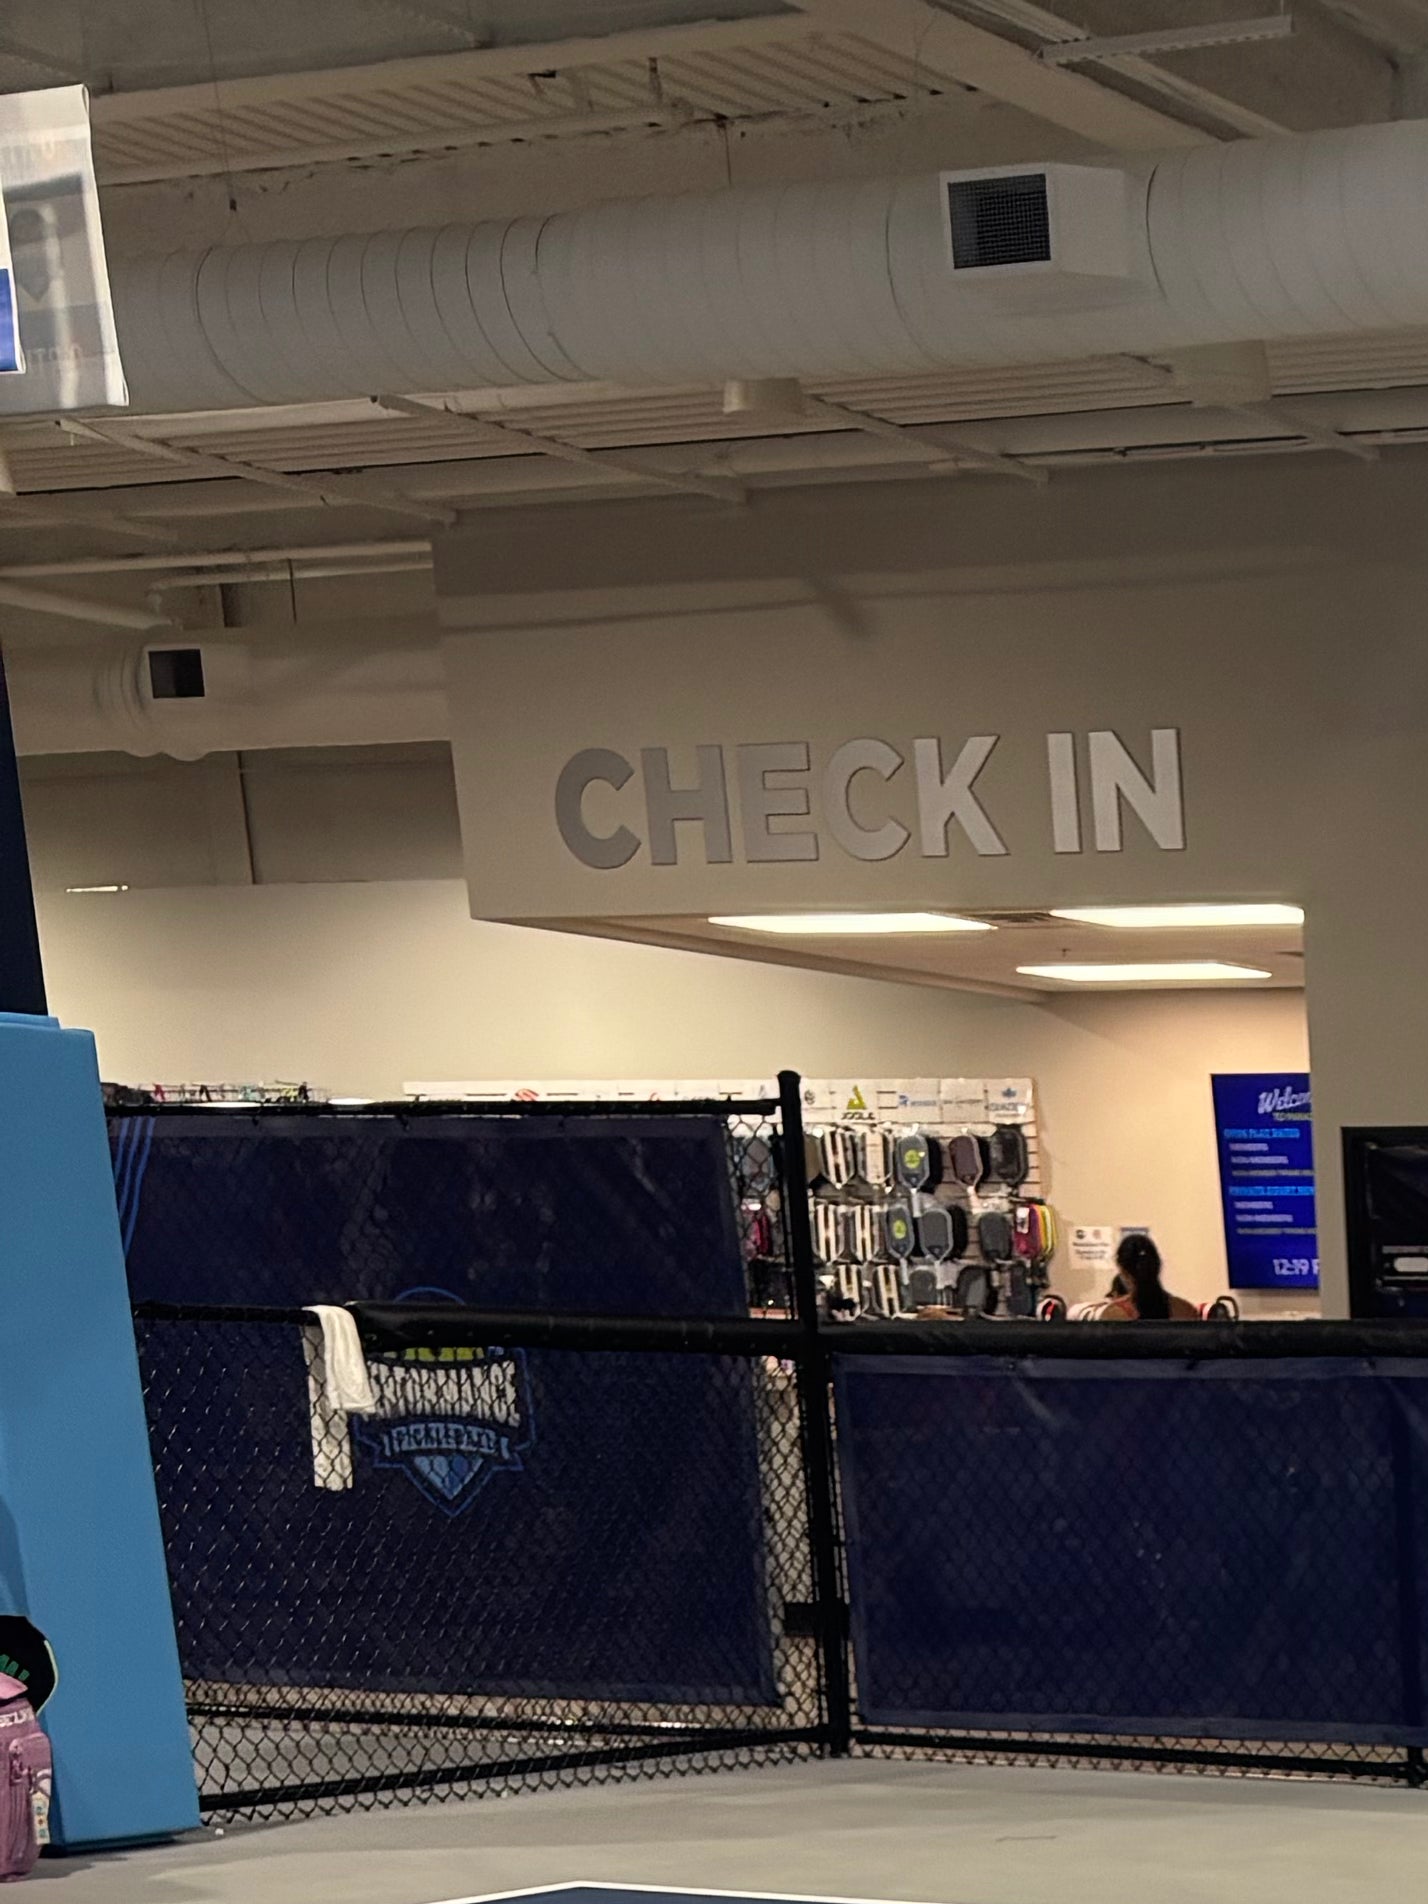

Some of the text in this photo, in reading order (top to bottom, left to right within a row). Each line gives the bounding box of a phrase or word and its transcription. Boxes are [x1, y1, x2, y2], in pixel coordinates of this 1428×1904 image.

[555, 727, 1187, 869] CHECK IN
[1257, 1085, 1313, 1114] Welcom
